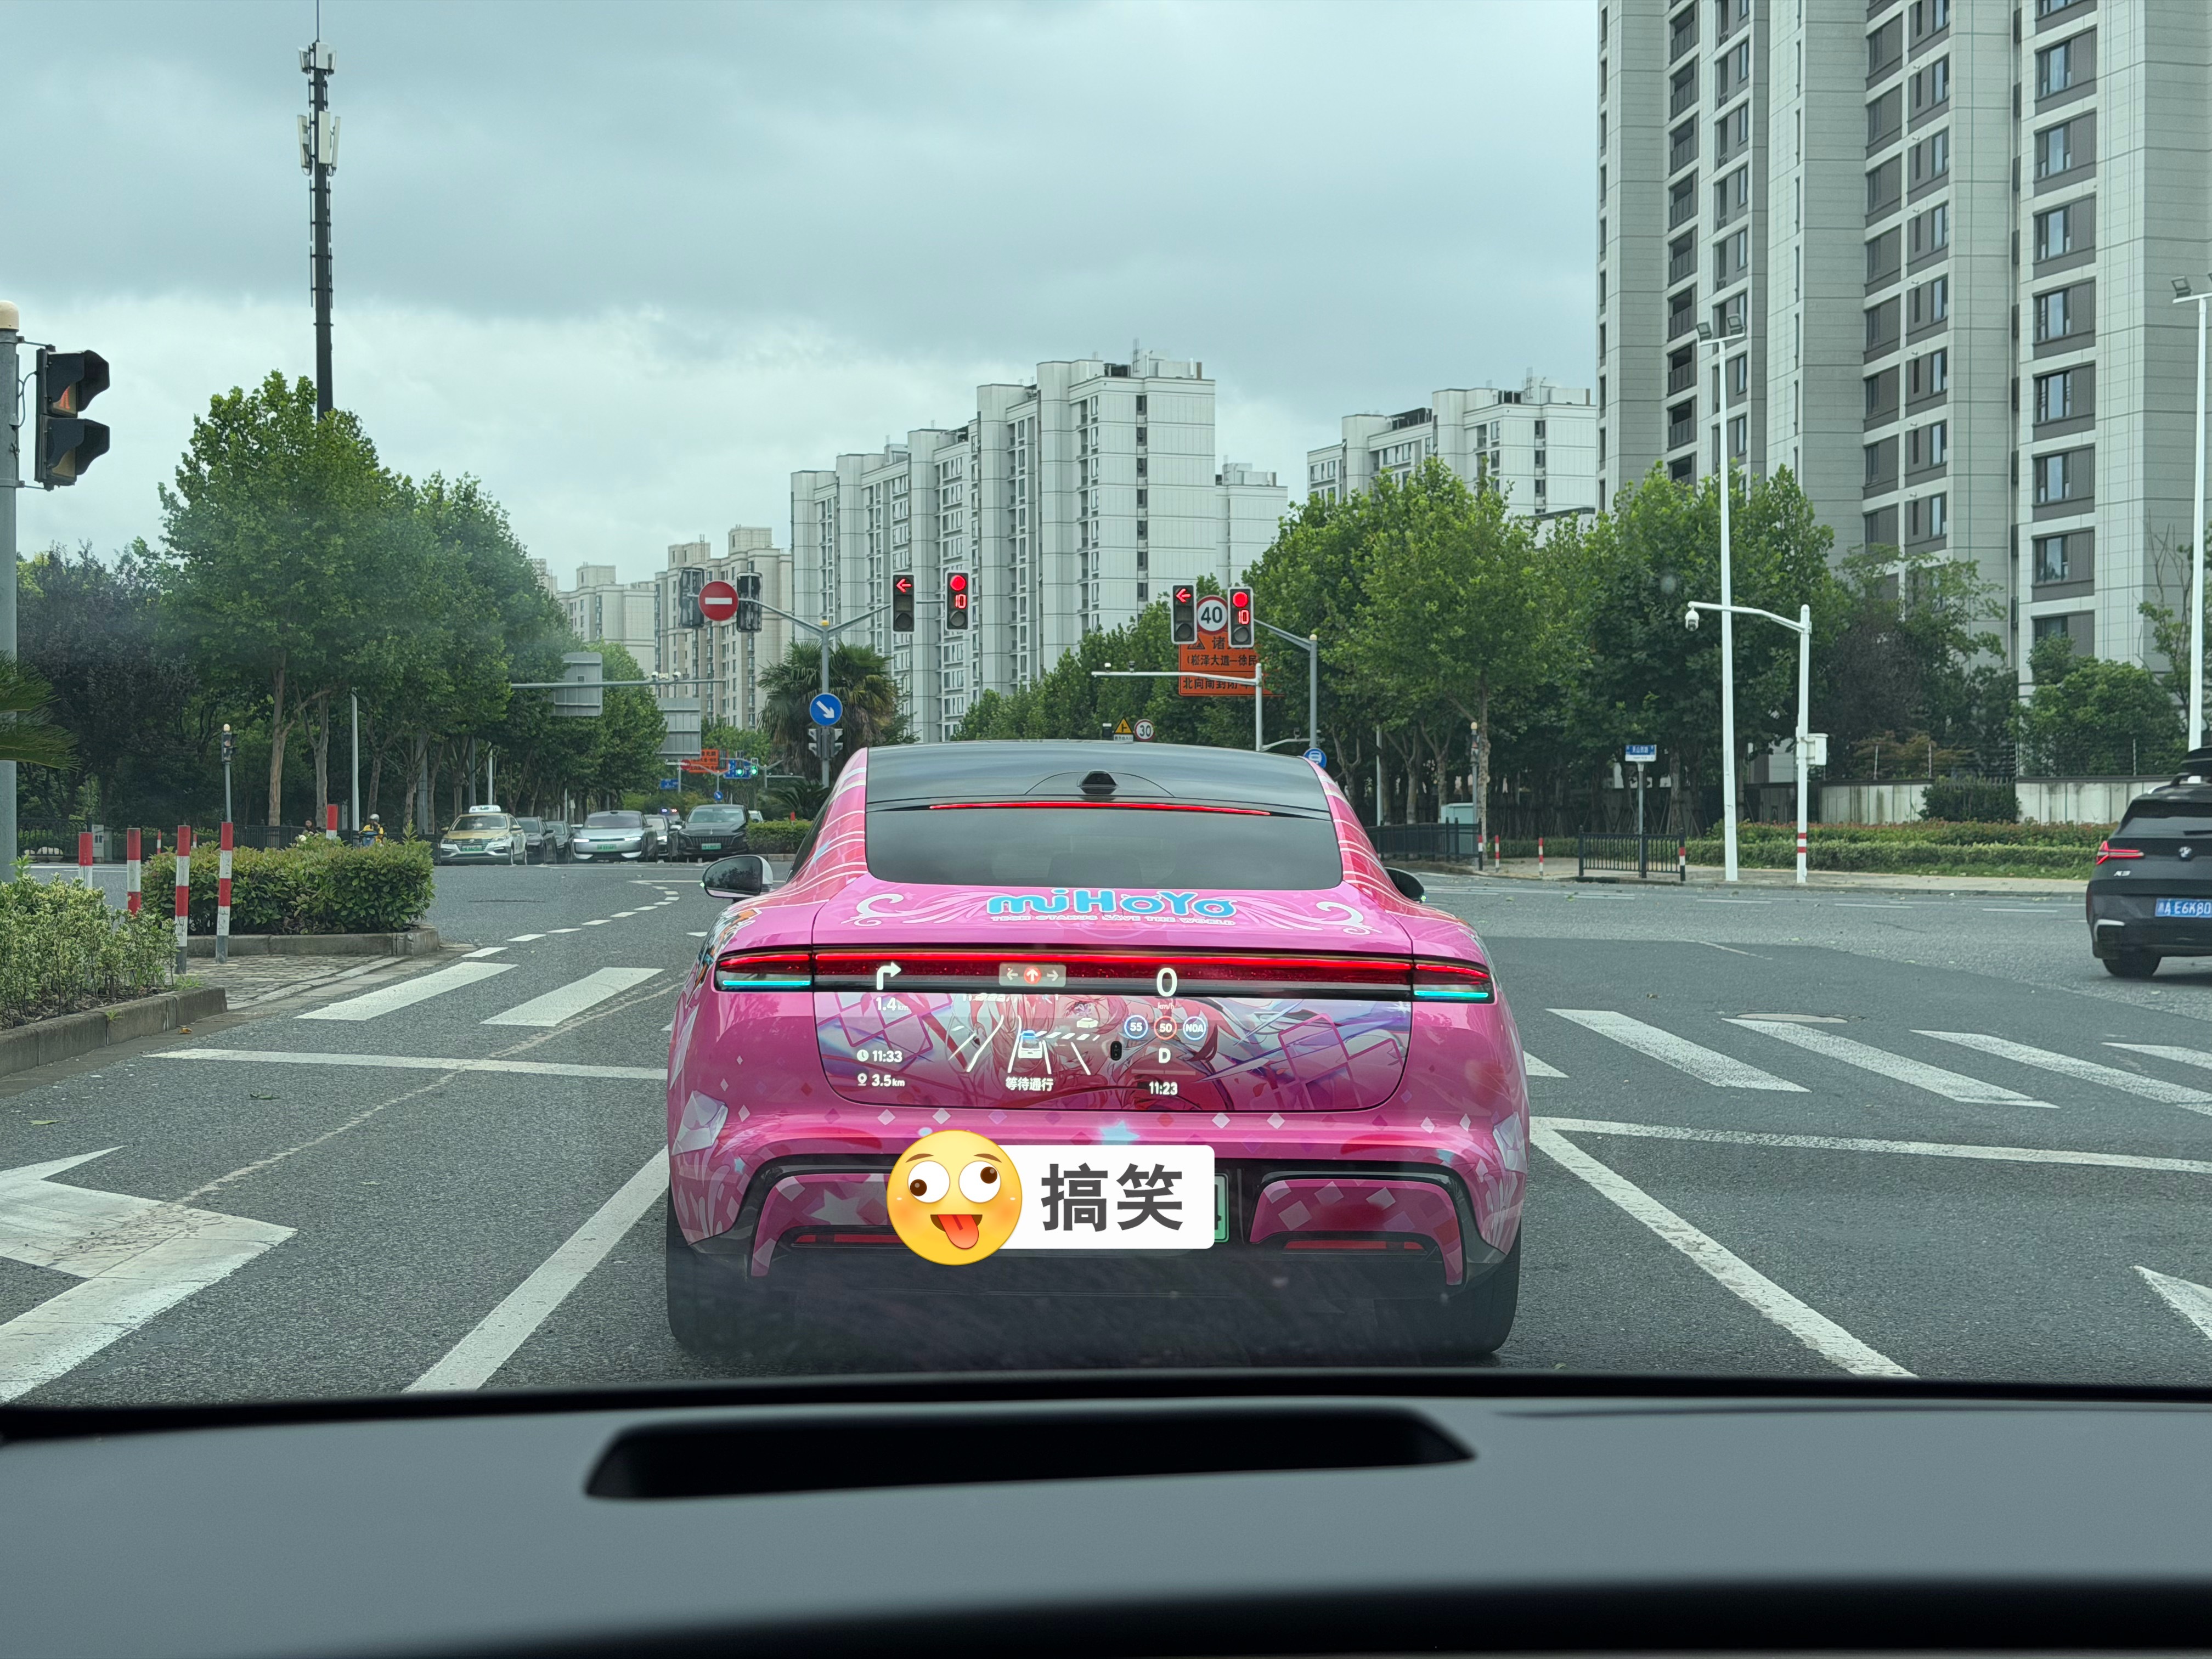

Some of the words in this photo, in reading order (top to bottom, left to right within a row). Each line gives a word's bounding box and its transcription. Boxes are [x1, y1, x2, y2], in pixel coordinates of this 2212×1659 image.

[955, 594, 967, 609] 10
[1200, 606, 1223, 624] 40
[1238, 609, 1249, 625] 10
[1139, 725, 1152, 737] 30
[987, 887, 1238, 918] miHoYo
[1156, 967, 1178, 997] 0
[1130, 1022, 1143, 1032] 55
[1159, 1023, 1172, 1033] 50
[1186, 1023, 1204, 1033] NOA
[872, 1050, 902, 1063] 11:33
[1159, 1048, 1171, 1063] D
[1006, 1076, 1054, 1092] 等待通行
[1149, 1081, 1178, 1096] 11:23
